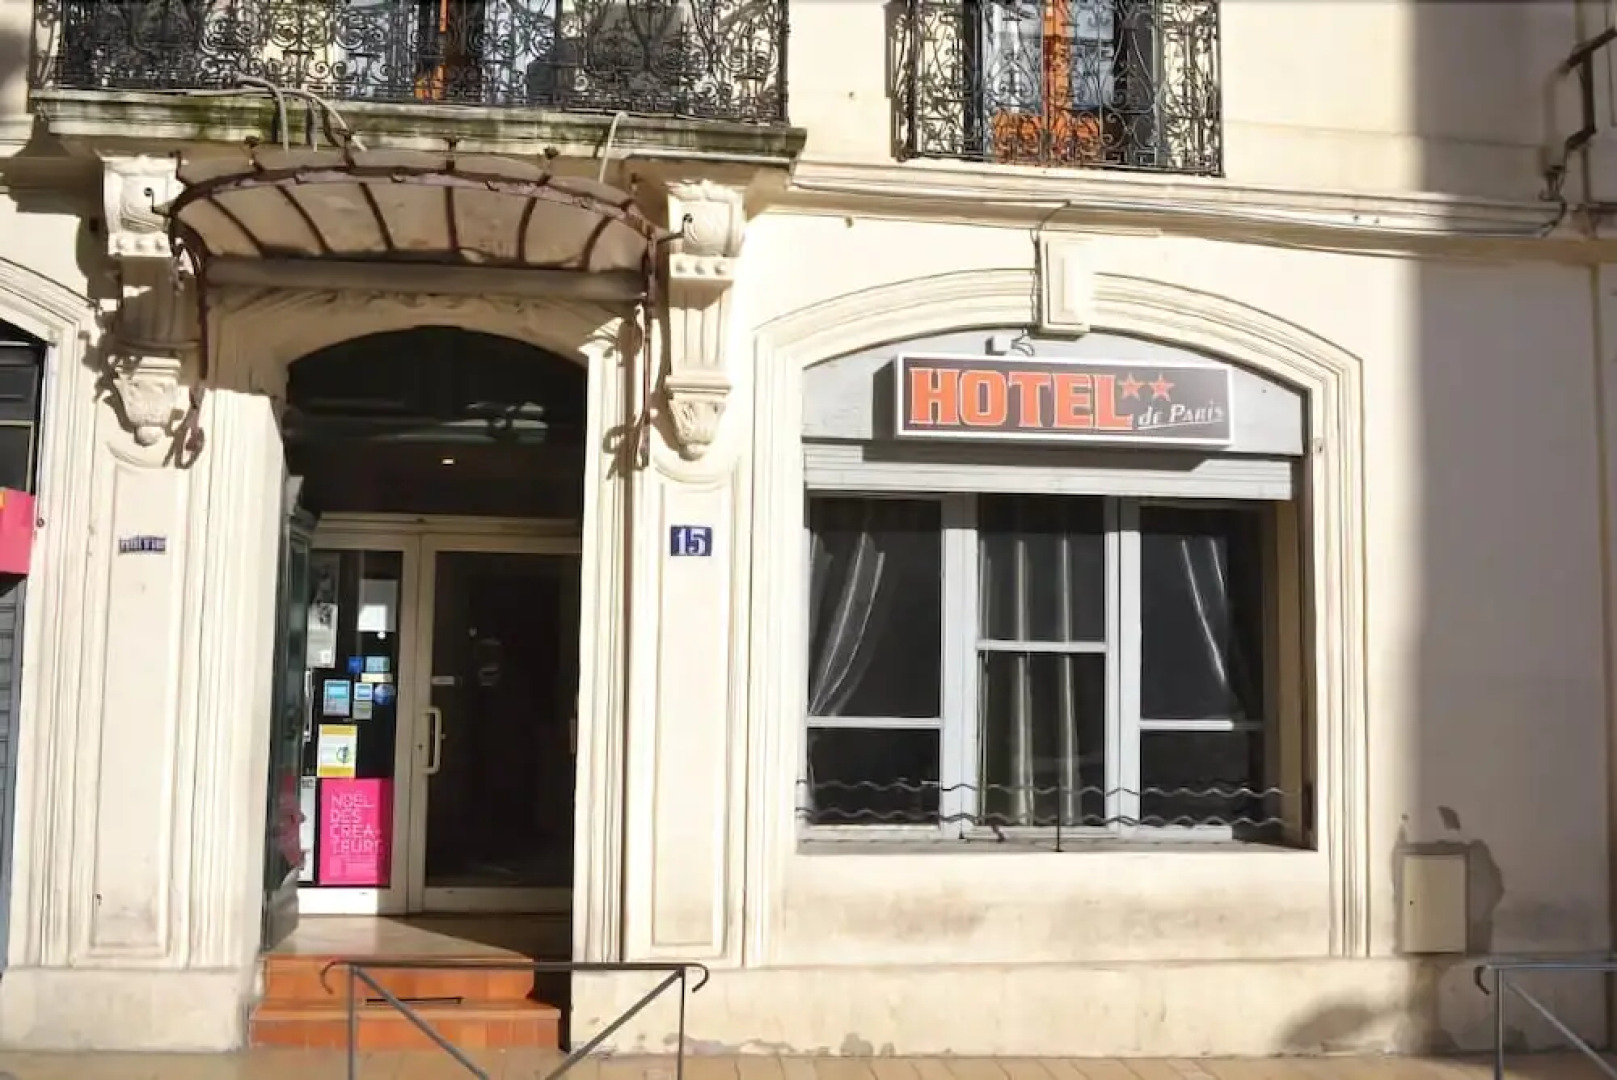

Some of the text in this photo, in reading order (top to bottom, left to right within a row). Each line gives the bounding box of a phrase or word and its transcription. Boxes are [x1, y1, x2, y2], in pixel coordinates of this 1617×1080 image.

[909, 367, 1133, 431] HOTEL
[1138, 406, 1162, 426] de
[677, 528, 706, 555] 15
